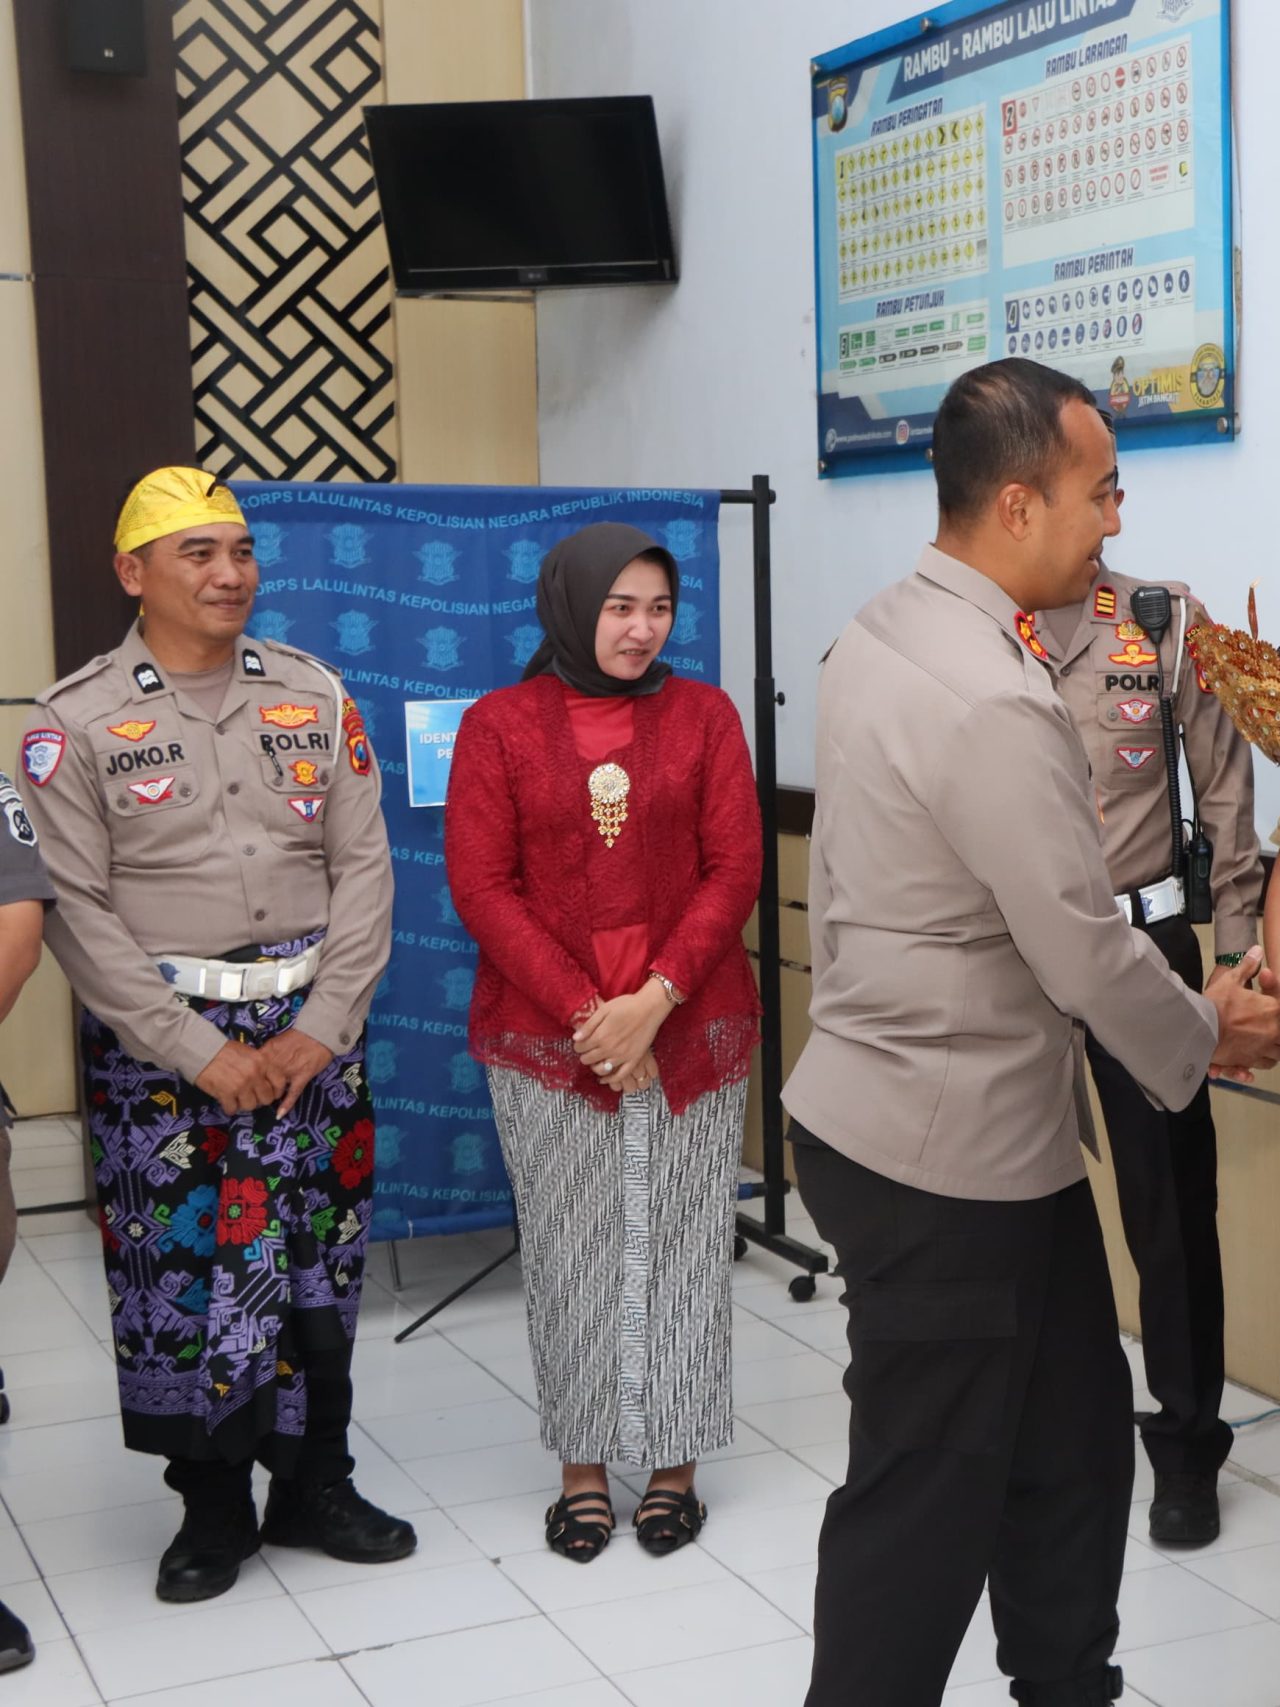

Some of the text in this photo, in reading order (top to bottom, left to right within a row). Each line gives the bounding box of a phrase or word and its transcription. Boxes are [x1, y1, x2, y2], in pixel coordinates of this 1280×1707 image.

[903, 40, 950, 83] RAMBU
[962, 15, 1014, 61] RAMBU
[1017, 2, 1056, 40] LALU
[1060, 0, 1119, 24] LINT
[1045, 33, 1128, 79] RAMBU LARANGAN
[871, 97, 944, 136] RAMBU PERINGATAN
[1054, 260, 1086, 282] RAMBU
[876, 289, 945, 319] RAMBU PETUNJUK
[240, 489, 705, 530] KORPS LALULINTAS KEPOLISIAN NEGARA REPUBLIK INDONESIA
[255, 578, 537, 616] ORPS LALULINTAS KEPOLISIAN NEGAR
[342, 667, 400, 689] ULINTAS
[1105, 674, 1160, 692] POLR
[260, 732, 330, 751] POLRI
[419, 732, 457, 745] IDENT
[106, 743, 185, 776] JOKO.R
